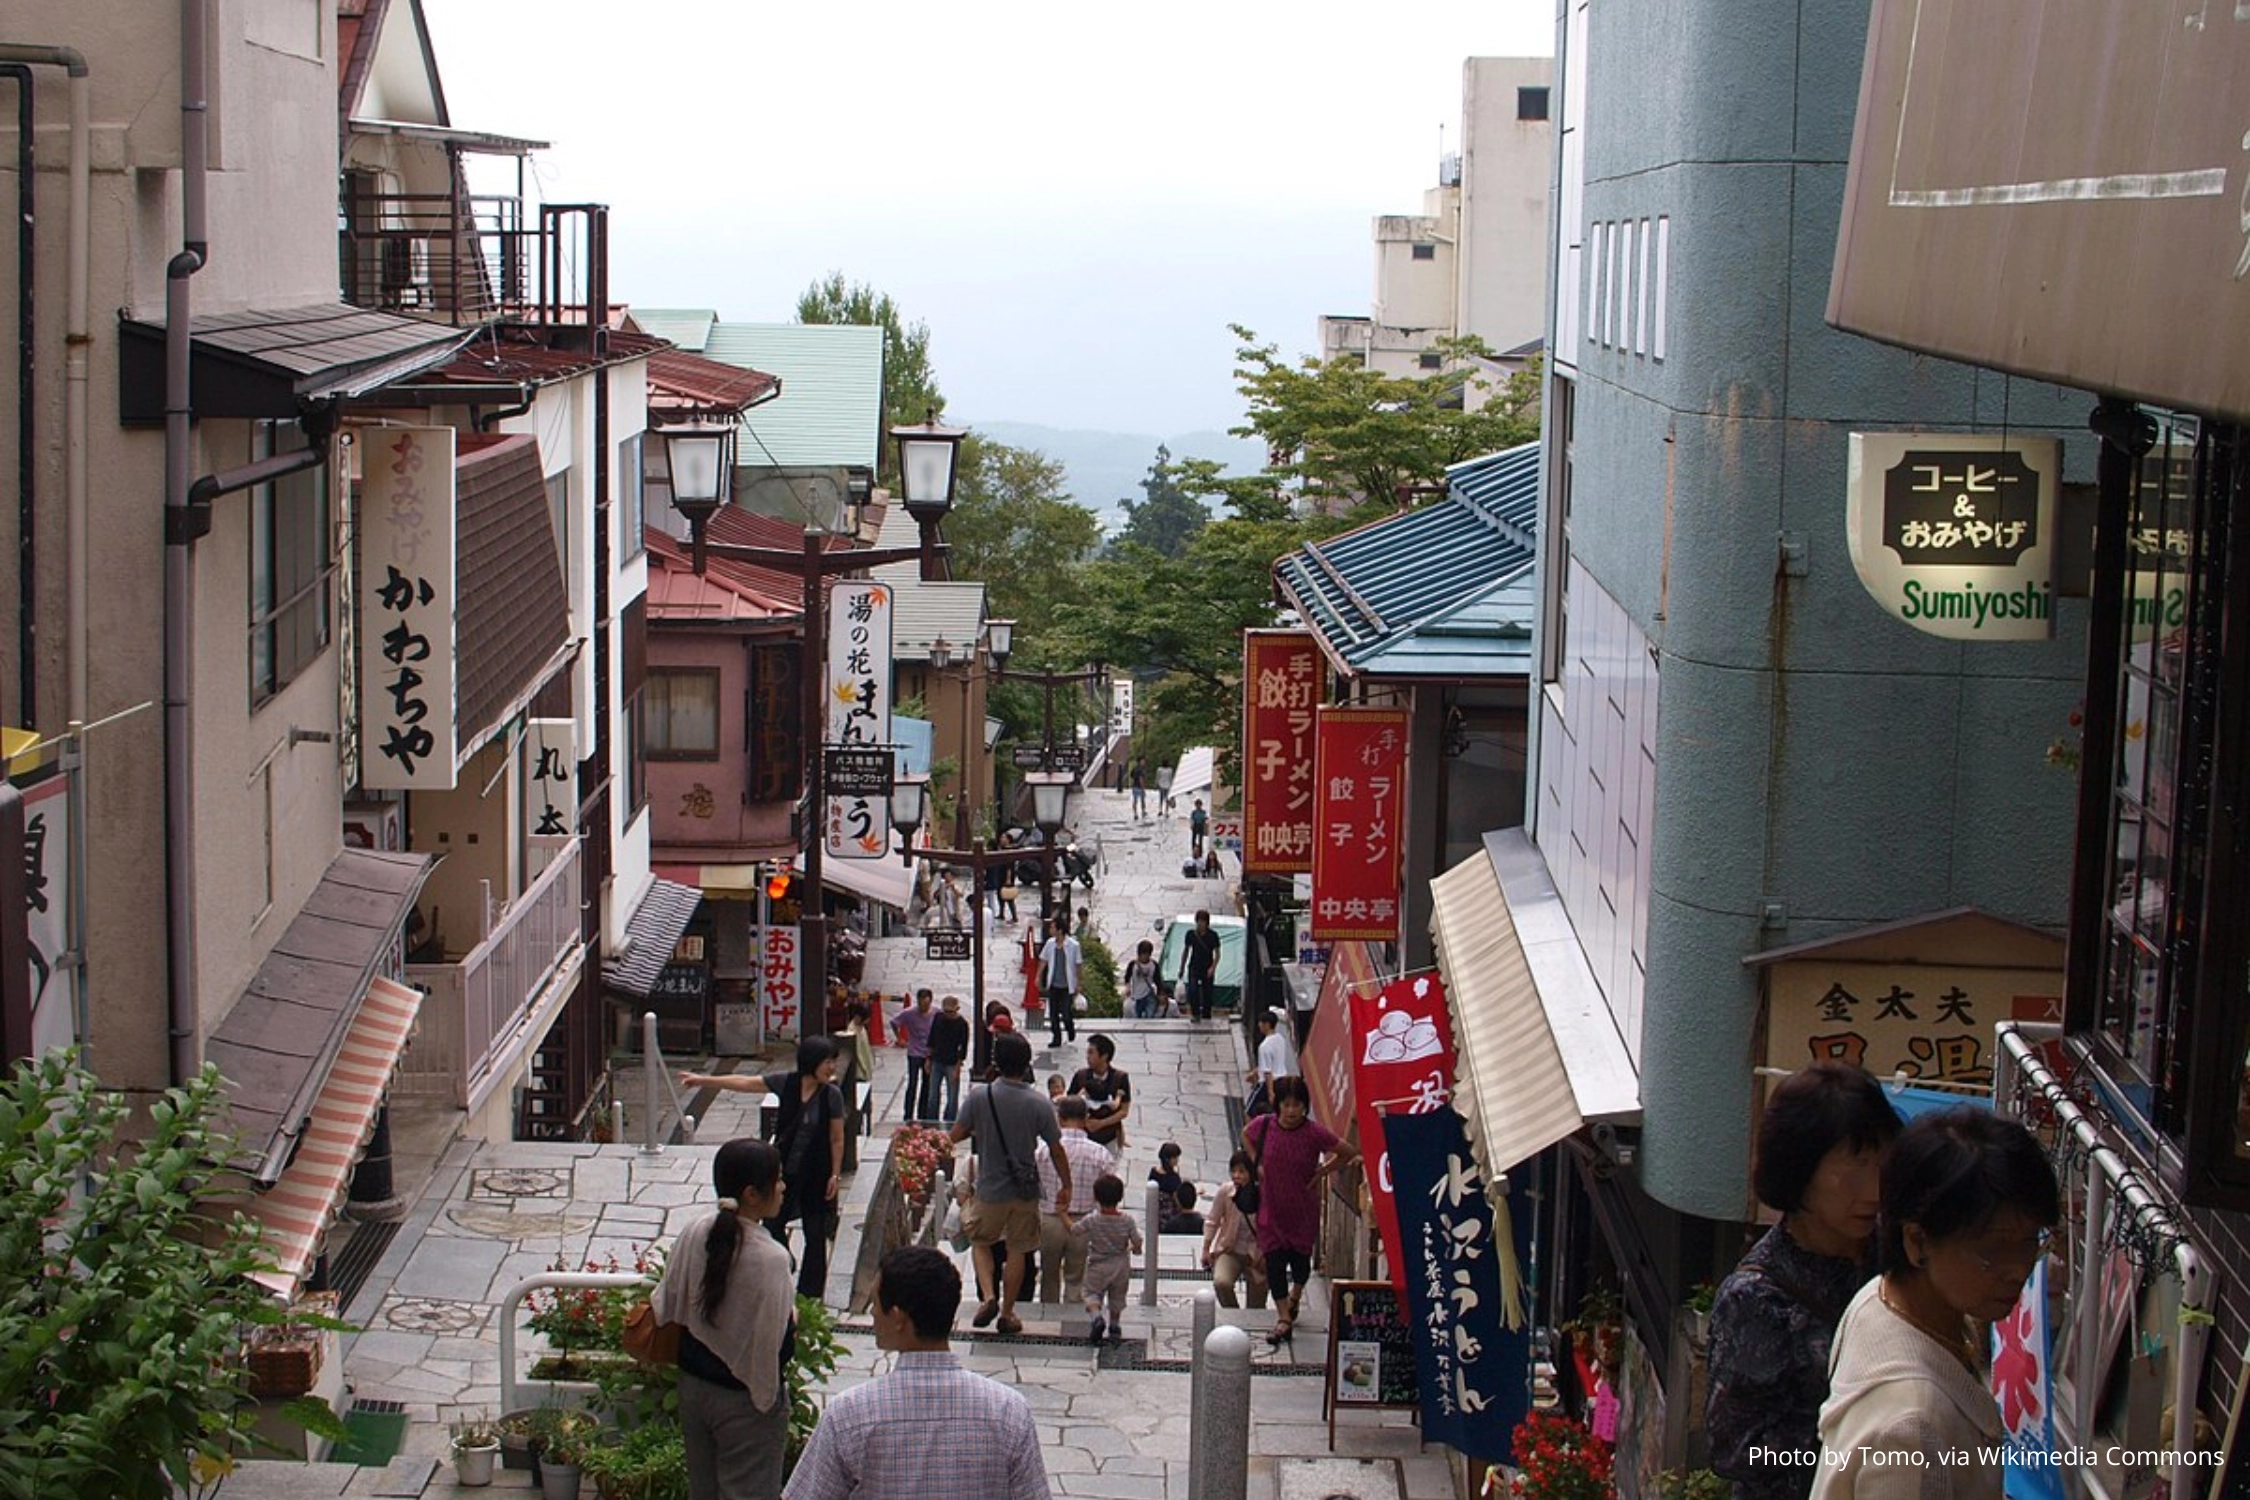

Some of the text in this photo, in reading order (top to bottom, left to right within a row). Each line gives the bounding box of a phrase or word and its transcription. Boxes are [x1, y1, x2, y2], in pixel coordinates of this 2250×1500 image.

[1911, 464, 2018, 492] コーヒー
[1952, 494, 1975, 518] &
[1900, 519, 2027, 549] おみやげ
[1901, 579, 2050, 629] Sumiyoshi
[375, 564, 434, 776] かわちや
[1256, 667, 1287, 781] 餃子
[1287, 653, 1313, 811] 手打ラーメン
[1257, 821, 1312, 856] 中央亭
[1328, 776, 1355, 847] 餃子
[1366, 776, 1391, 865] ラーメン
[1319, 897, 1394, 922] 中央亭
[764, 928, 796, 1031] おみやげ
[1815, 983, 1976, 1025] 金太夫
[1428, 1153, 1496, 1414] 水沢うどん
